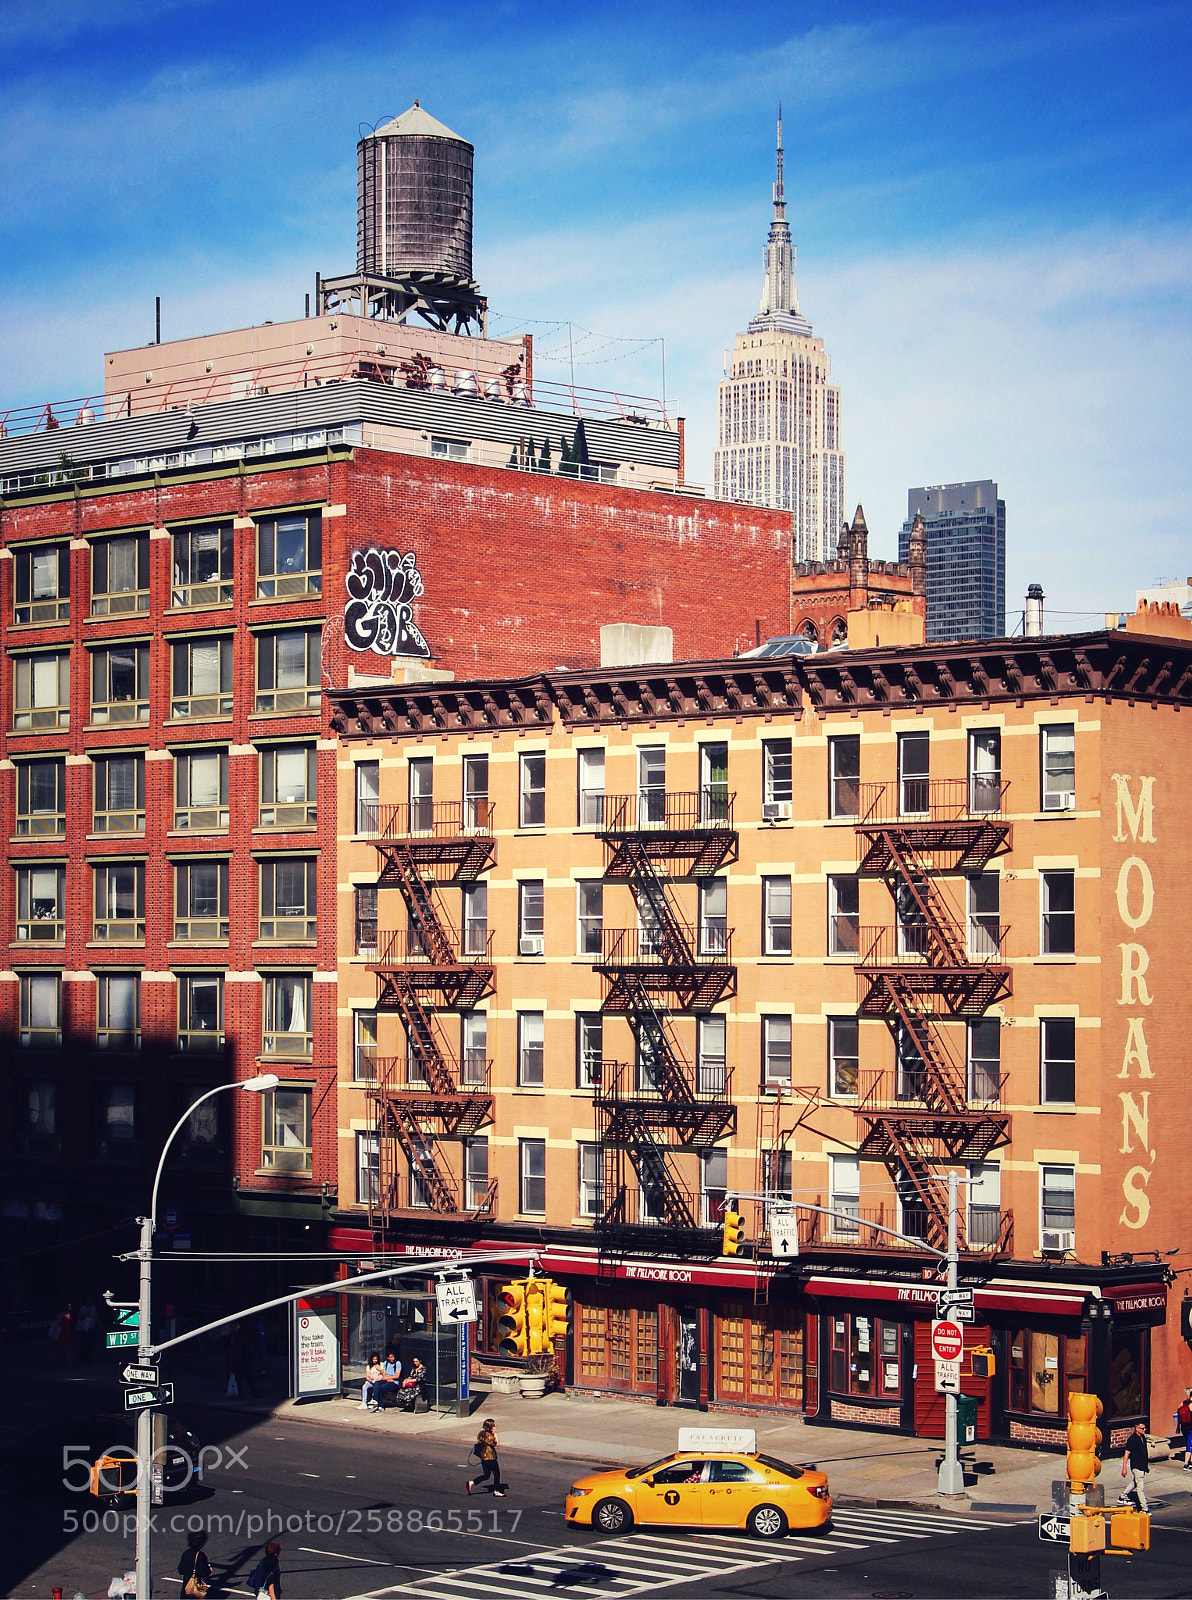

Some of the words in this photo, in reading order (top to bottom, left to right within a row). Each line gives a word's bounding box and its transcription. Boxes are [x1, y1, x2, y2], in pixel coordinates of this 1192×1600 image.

[405, 1245, 415, 1255] THE
[626, 1267, 637, 1277] THE
[637, 1268, 668, 1280] FILLMORE
[669, 1270, 692, 1282] ROOM
[446, 1286, 464, 1296] ALL
[897, 1289, 910, 1301] THE
[910, 1289, 940, 1302] FILLMO
[440, 1296, 472, 1307] TRAFFIC
[1116, 1300, 1125, 1310] THE
[1149, 1297, 1166, 1307] ROOM
[109, 1334, 117, 1345] W
[120, 1333, 128, 1345] 19
[939, 1345, 956, 1353] ENTER
[940, 1363, 954, 1371] ALL
[126, 1369, 138, 1378] ONE
[140, 1370, 153, 1380] WAY
[937, 1371, 958, 1380] TRAFFIC
[132, 1393, 146, 1403] ONE
[1046, 1523, 1067, 1535] ONE
